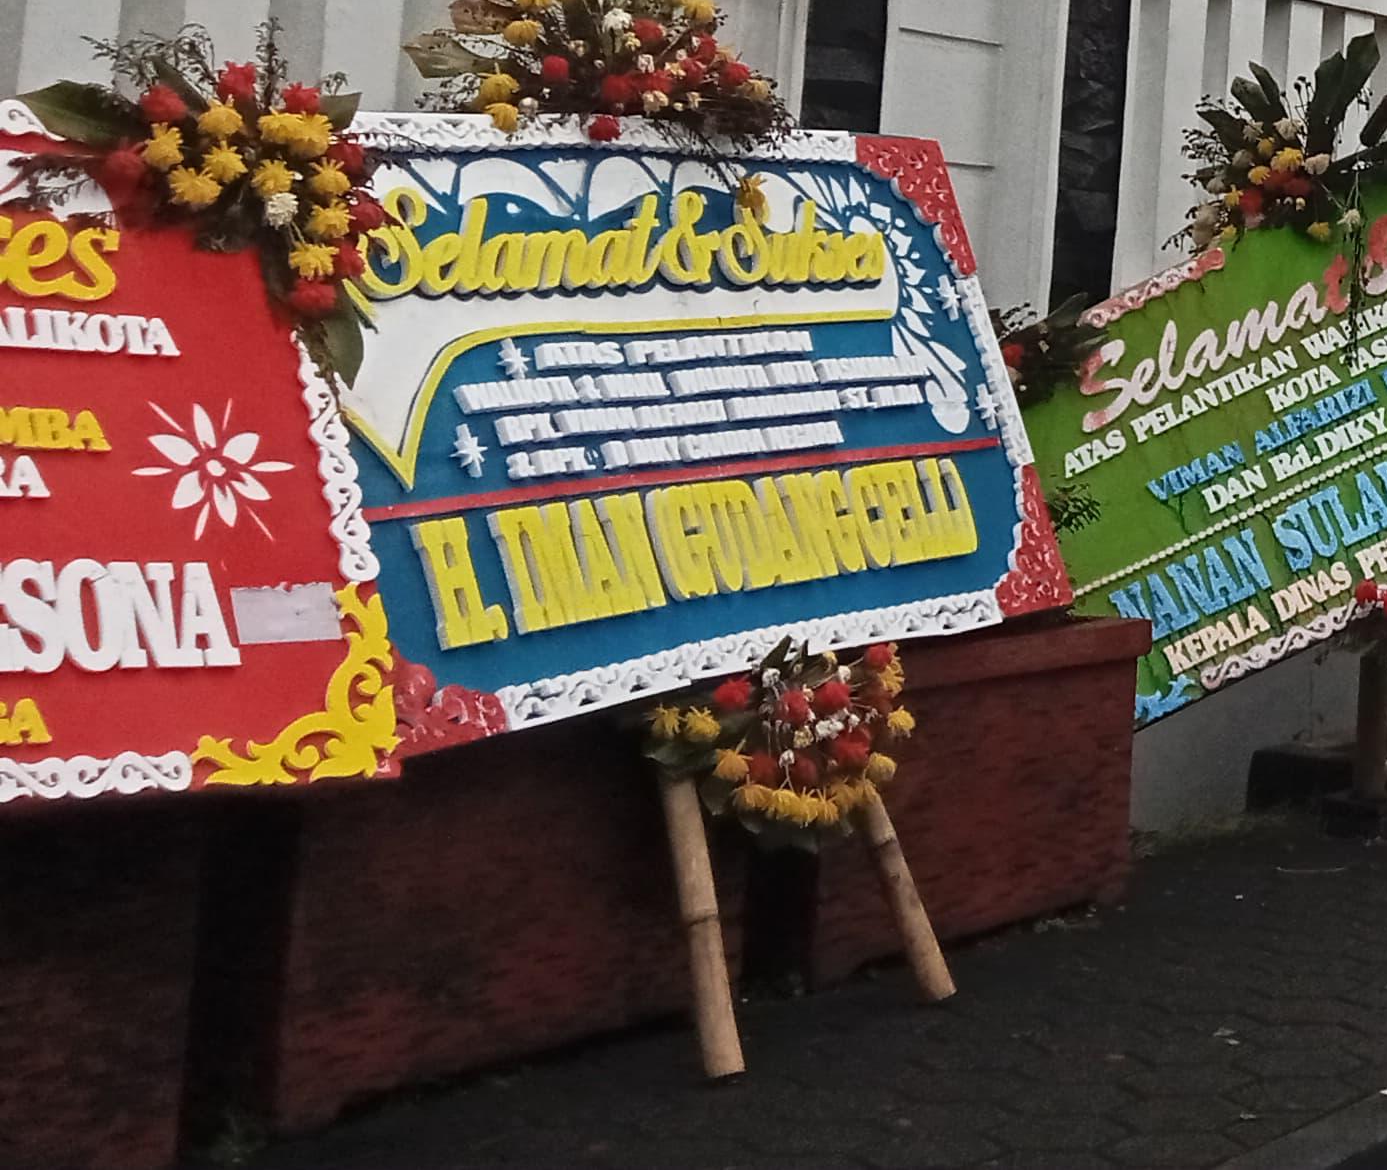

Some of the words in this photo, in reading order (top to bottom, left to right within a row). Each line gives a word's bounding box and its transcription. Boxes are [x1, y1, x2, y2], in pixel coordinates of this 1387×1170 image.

[360, 186, 660, 298] Selamat
[658, 190, 719, 283] &
[719, 196, 886, 287] Sukses
[534, 341, 625, 371] ATAS
[1080, 253, 1351, 434] Selamat
[1264, 362, 1341, 413] KOTA
[1063, 430, 1128, 479] ATAS
[1130, 345, 1299, 443] PELANTIKAN
[1147, 440, 1247, 502] VIMAN
[1254, 378, 1379, 456] ALFARIZI
[1201, 464, 1268, 514] DAN
[1162, 605, 1271, 675] KEPALA
[1270, 561, 1353, 622] DINAS
